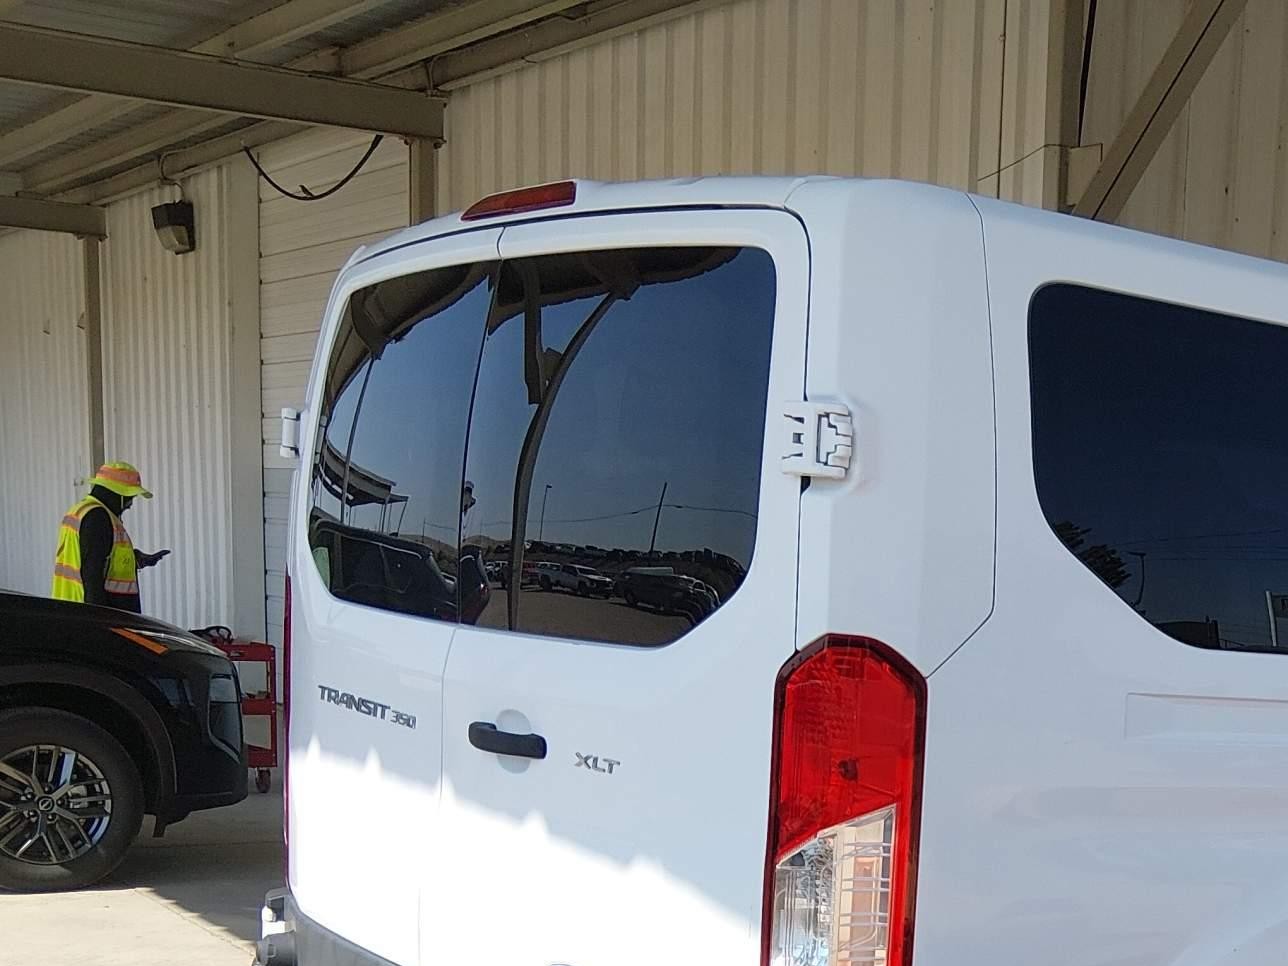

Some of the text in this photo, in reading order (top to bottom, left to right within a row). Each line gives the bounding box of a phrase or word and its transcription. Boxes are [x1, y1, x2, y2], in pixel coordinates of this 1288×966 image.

[318, 684, 417, 729] TRANSIT 350
[574, 751, 621, 774] XLT
